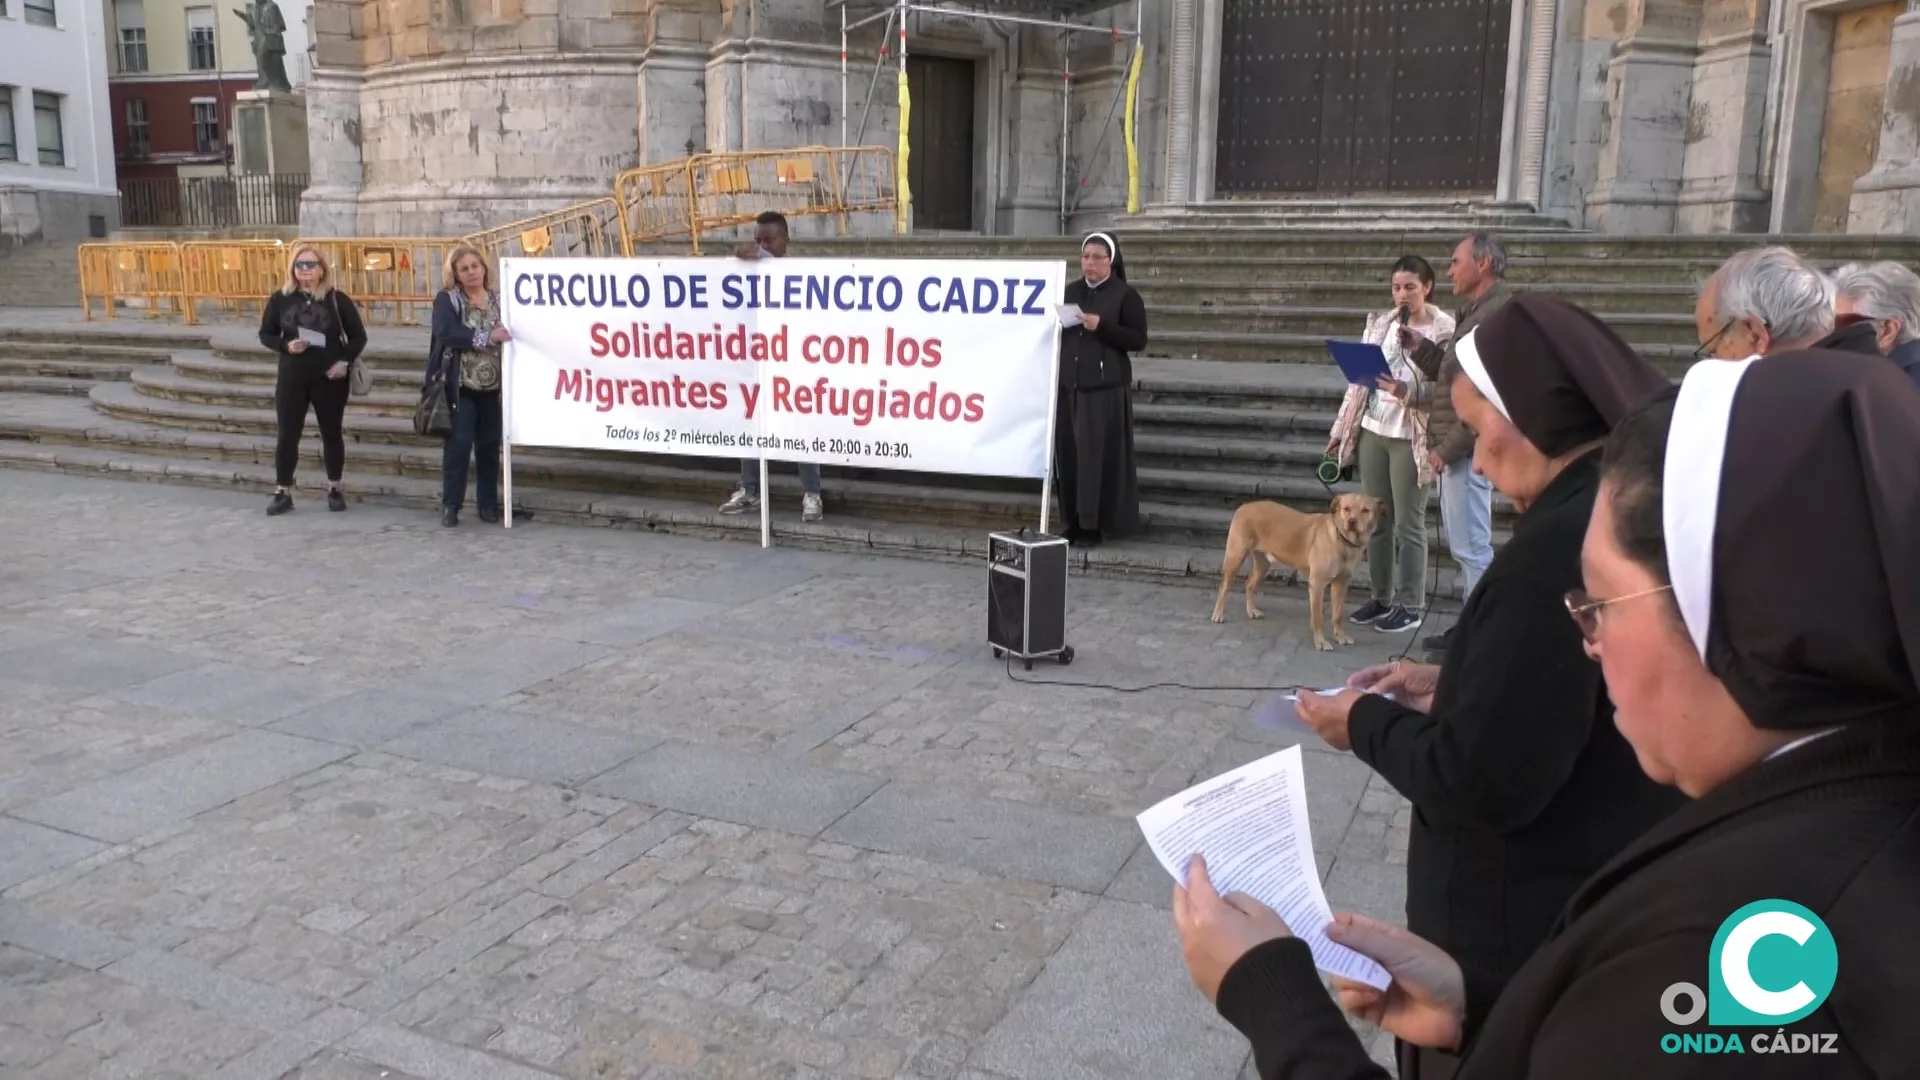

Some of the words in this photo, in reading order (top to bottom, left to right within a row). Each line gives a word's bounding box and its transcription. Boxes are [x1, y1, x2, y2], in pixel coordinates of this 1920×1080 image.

[514, 273, 650, 309] CIRCULO
[664, 275, 709, 309] DE
[721, 275, 903, 312] SILENCIO
[917, 277, 1047, 315] CADIZ
[590, 322, 789, 362] Solidaridad
[802, 335, 870, 365] con
[886, 327, 942, 368] los
[554, 369, 728, 412] Migrantes
[739, 383, 761, 419] y
[772, 377, 985, 426] Refugiados
[605, 425, 640, 441] Todos
[642, 427, 660, 443] los
[680, 430, 735, 447] miércoles
[739, 434, 753, 447] de
[757, 434, 780, 448] cada
[783, 439, 810, 453] mes,
[812, 439, 826, 453] de
[829, 439, 862, 455] 20:00
[864, 446, 872, 456] a
[875, 443, 912, 458] 20:30.
